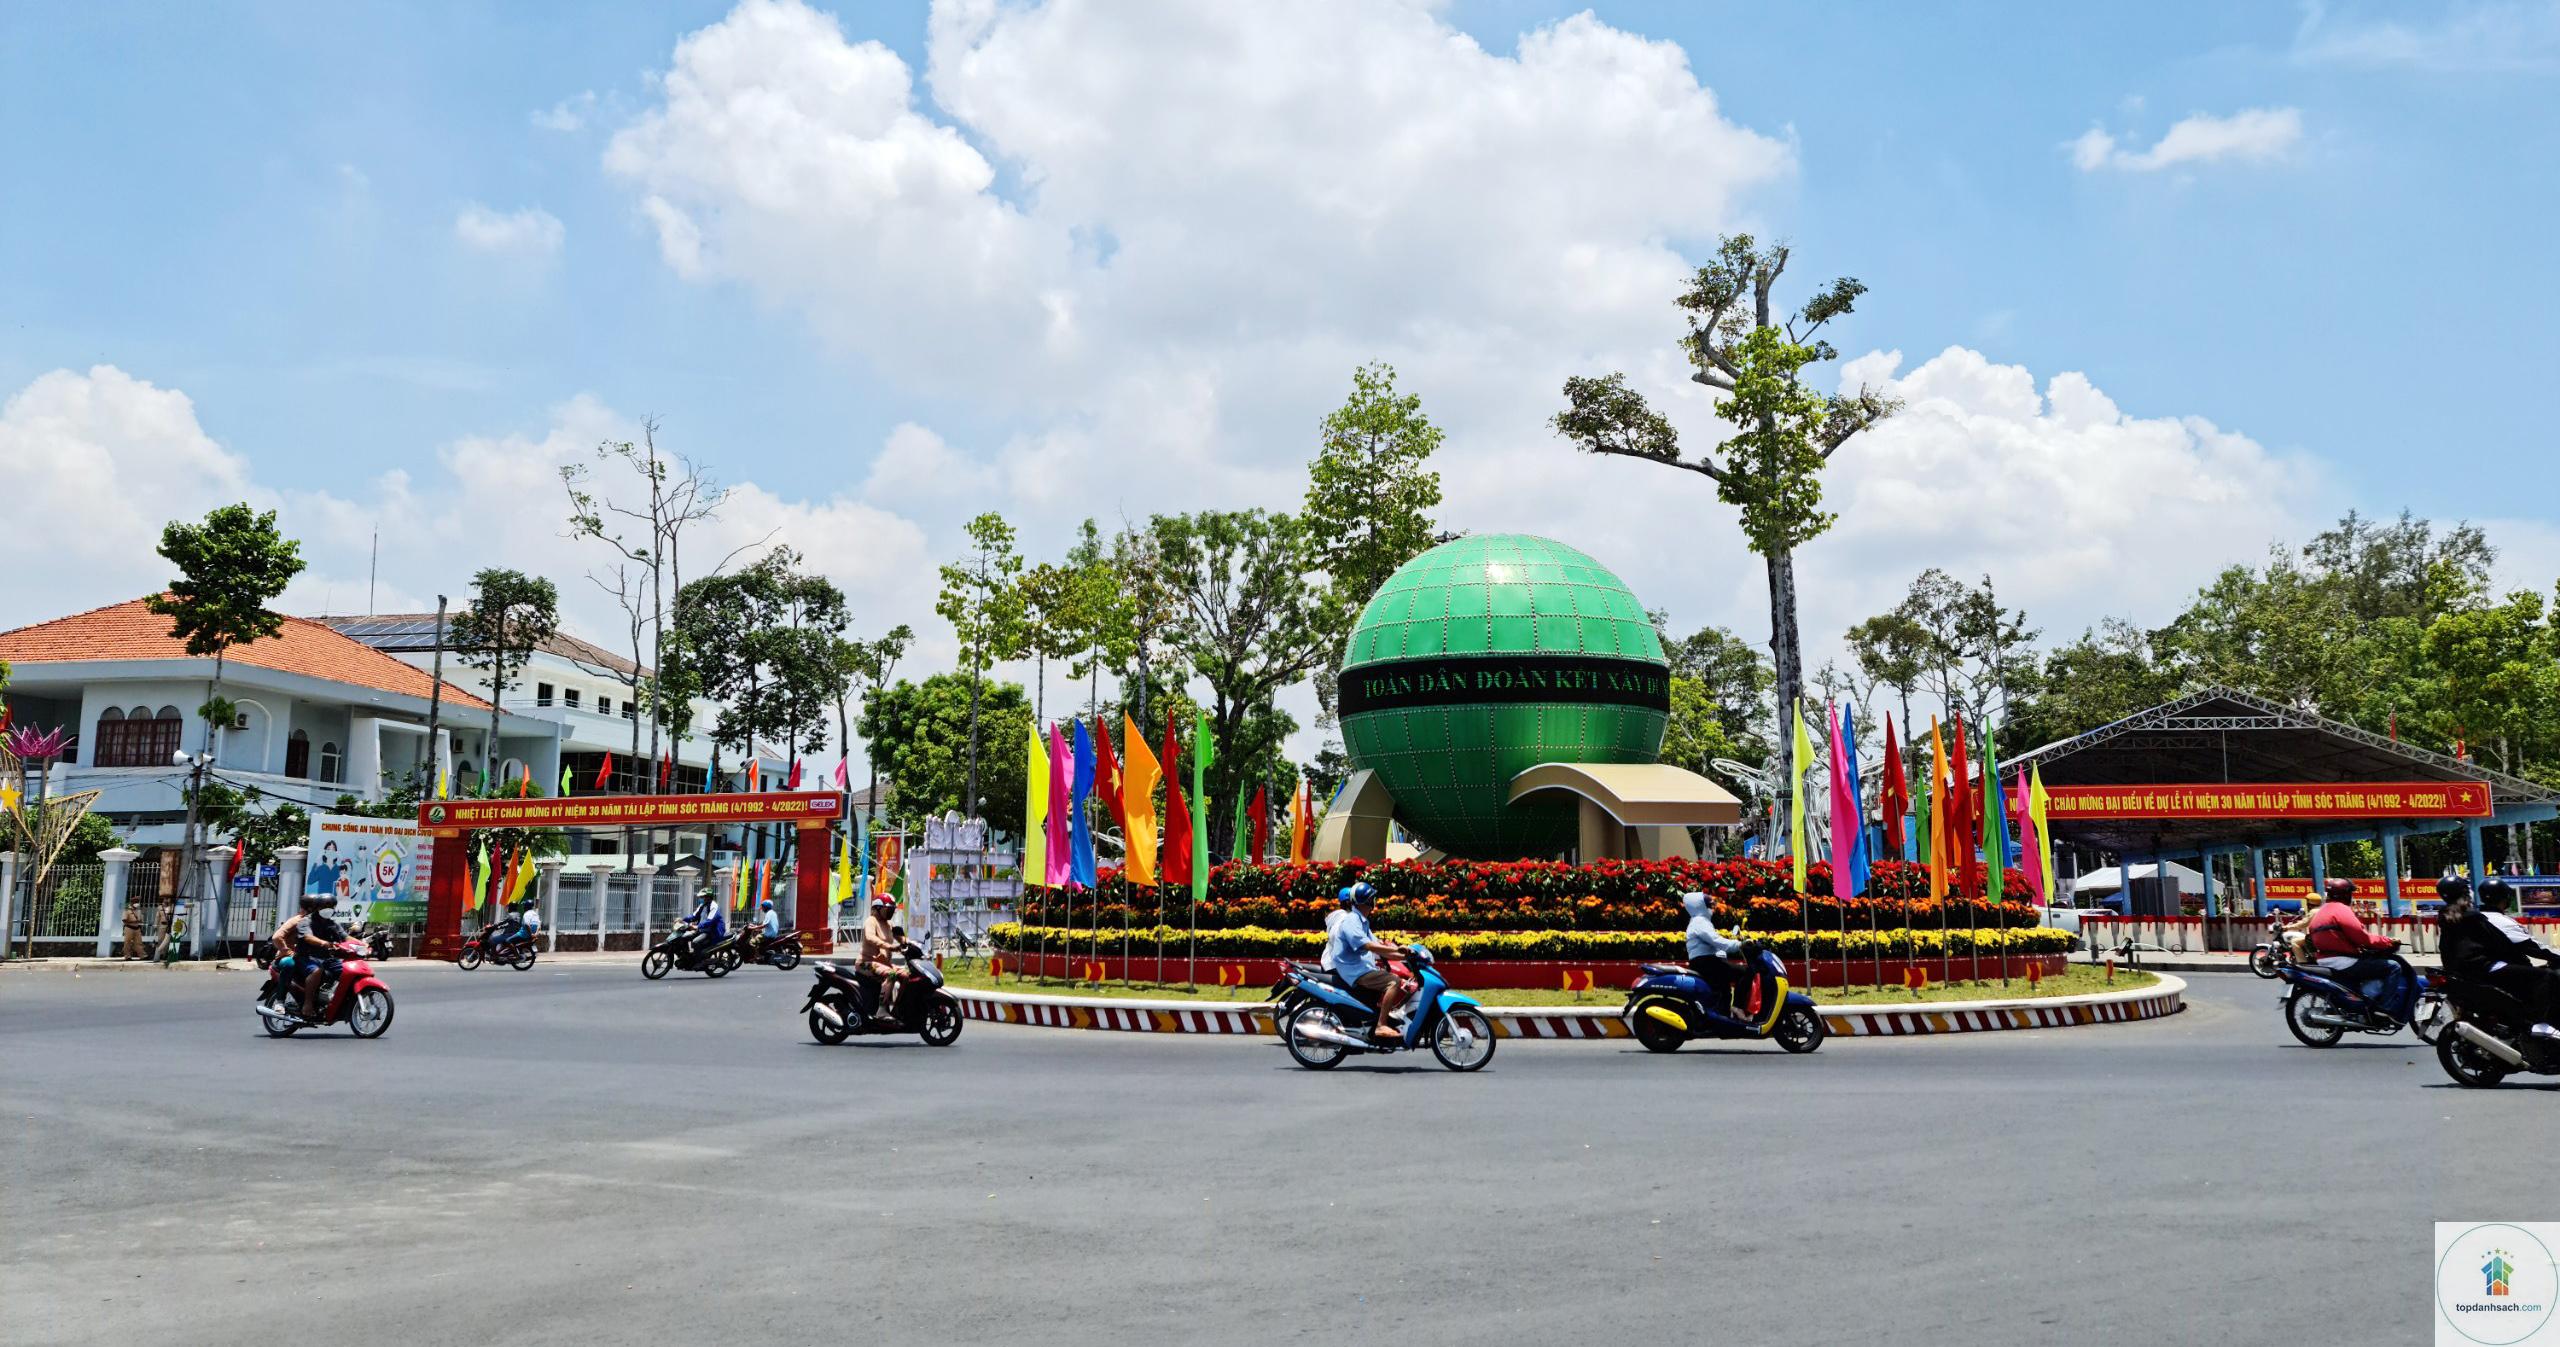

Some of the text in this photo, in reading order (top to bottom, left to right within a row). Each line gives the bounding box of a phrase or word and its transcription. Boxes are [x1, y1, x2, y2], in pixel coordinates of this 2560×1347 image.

[1363, 671, 1412, 698] TOÀN
[1419, 667, 1467, 692] DÂN
[1476, 666, 1547, 689] ĐOÀN
[1607, 667, 1643, 692] XÂY
[455, 807, 480, 821] NHIỆT
[481, 807, 498, 821] LIỆT
[500, 805, 523, 819] CHÀO
[525, 804, 550, 818] MỪNG
[564, 805, 586, 819] NIỆM
[589, 806, 600, 816] 30
[601, 804, 622, 816] NĂM
[624, 803, 637, 815] TÁI
[639, 801, 655, 818] LẬP
[658, 801, 677, 814] TỈNH
[680, 801, 697, 814] SÓC
[700, 801, 728, 814] TRĂNG
[730, 801, 764, 814] (4/1992
[2054, 794, 2076, 811] CHÀO
[2079, 793, 2105, 810] MỪNG
[2106, 797, 2120, 813] ĐẠI
[2123, 790, 2141, 810] BIỂU
[2156, 794, 2169, 813] DỰ
[2170, 790, 2181, 809] LỄ
[2196, 792, 2218, 813] NIỆM
[2221, 795, 2232, 809] 30
[2234, 792, 2254, 809] NĂM
[2256, 792, 2271, 809] TÁI
[2273, 791, 2289, 812] LẬP
[2291, 790, 2313, 809] TỈNH
[2314, 791, 2333, 809] SÓC
[2334, 791, 2365, 809] TRĂNG
[2367, 794, 2401, 810] (4/1992
[382, 866, 395, 876] 5K
